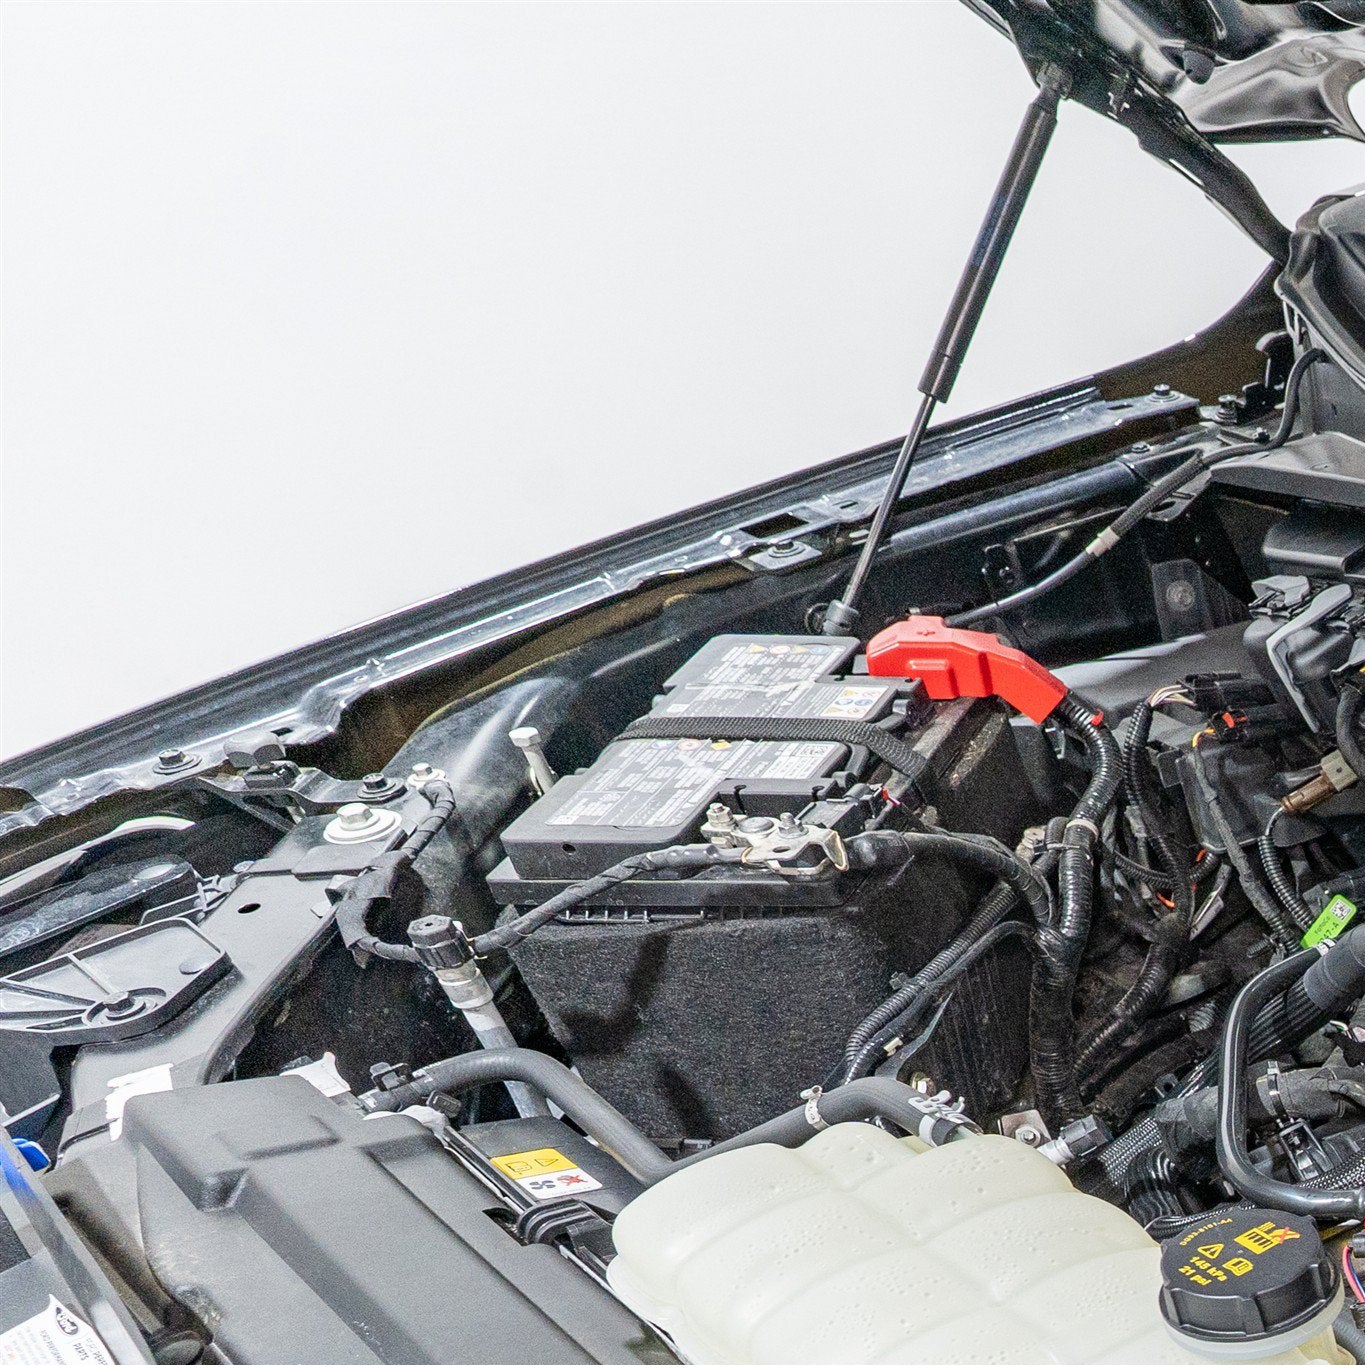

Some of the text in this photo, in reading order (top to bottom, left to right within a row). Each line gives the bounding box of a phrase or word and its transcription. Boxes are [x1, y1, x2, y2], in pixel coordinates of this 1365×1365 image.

[1188, 1254, 1210, 1271] 145
[1177, 1264, 1212, 1286] 21 psi
